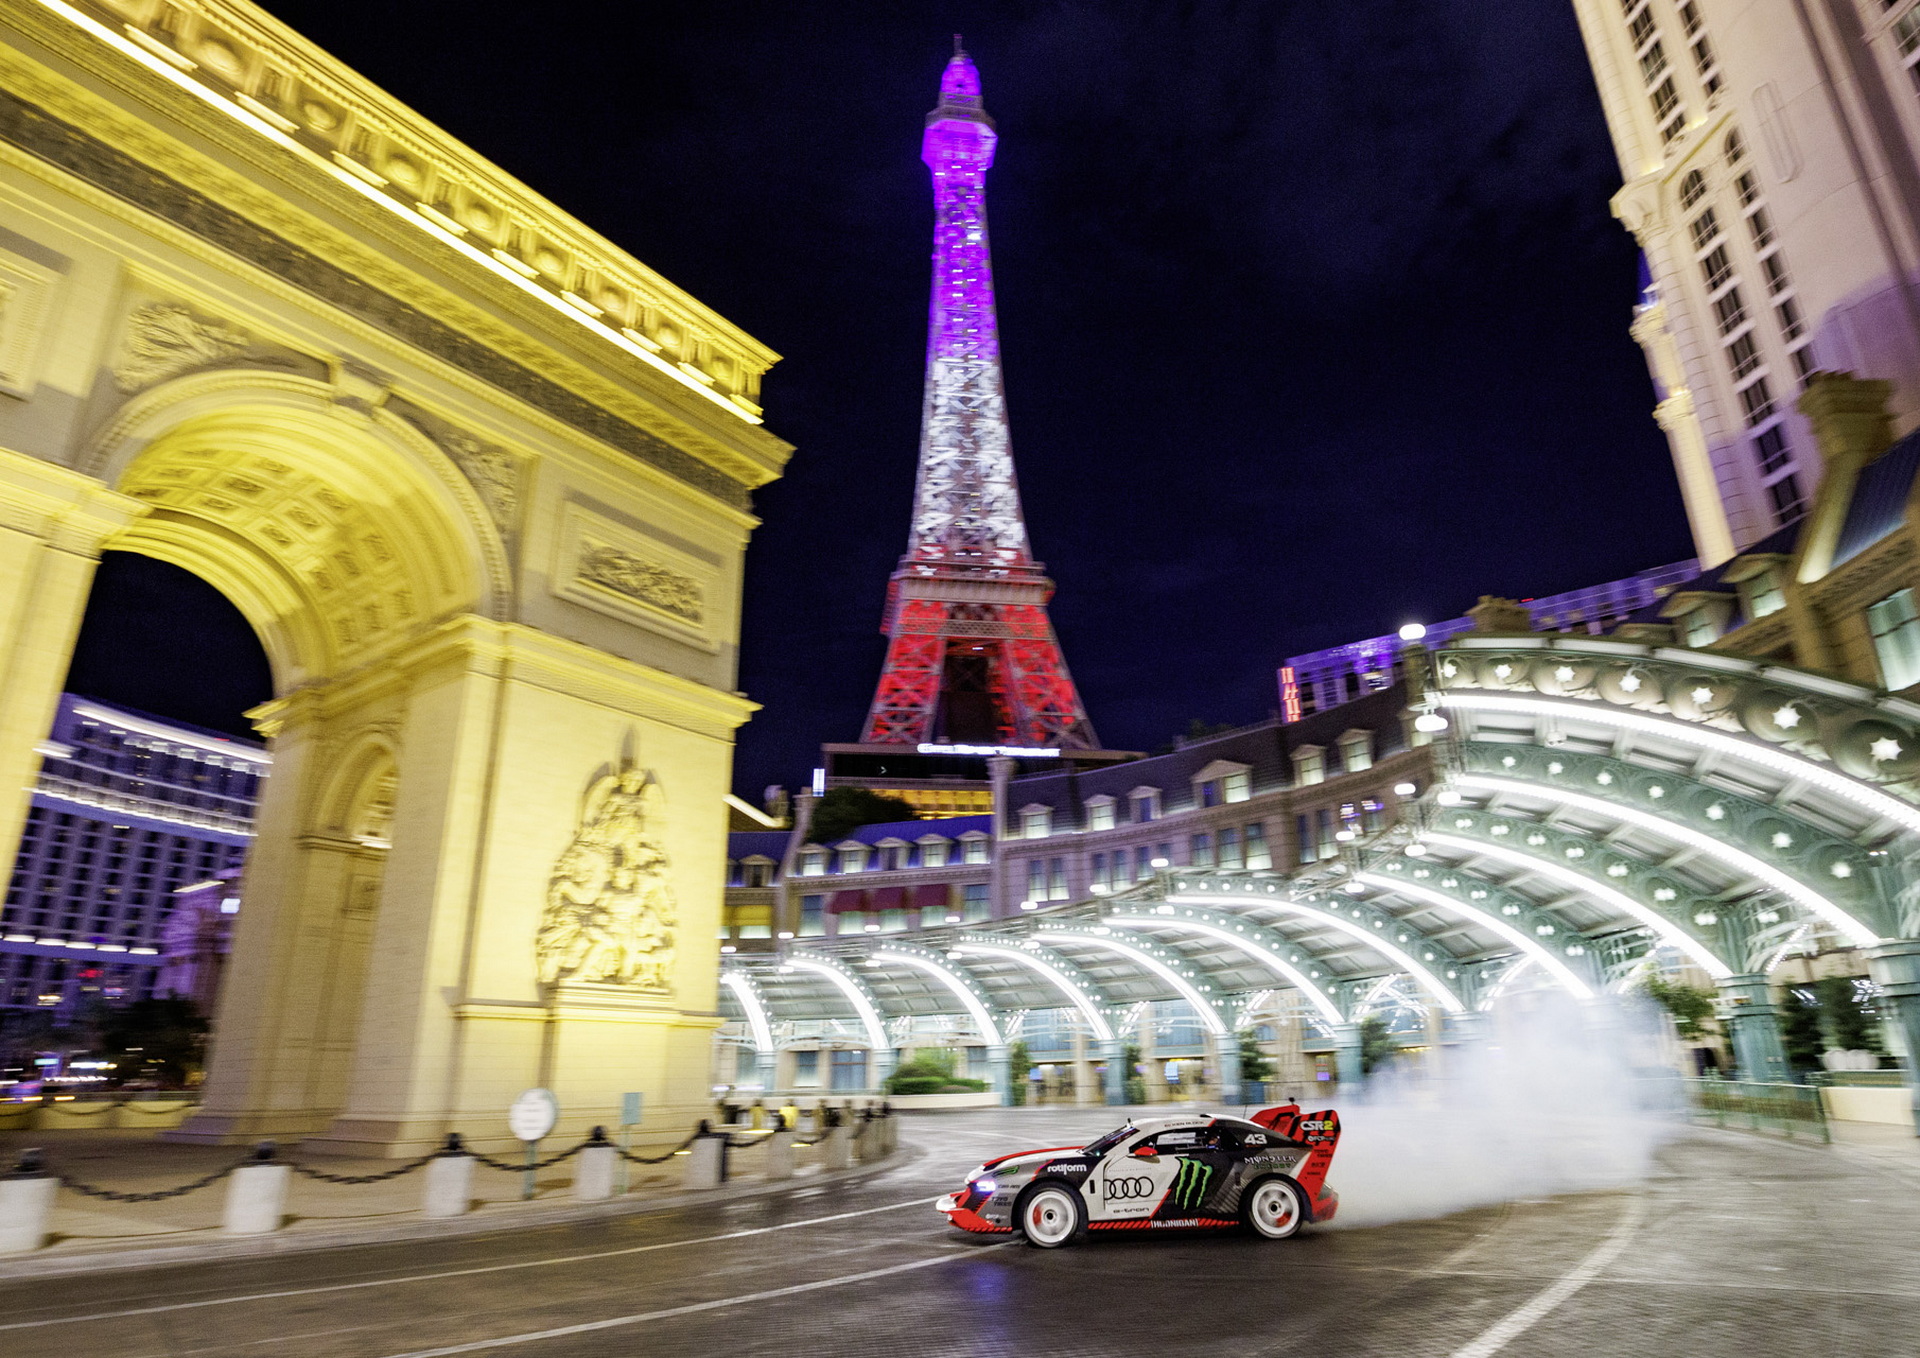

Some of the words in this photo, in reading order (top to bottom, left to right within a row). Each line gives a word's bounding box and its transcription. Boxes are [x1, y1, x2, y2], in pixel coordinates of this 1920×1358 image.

[1300, 1120, 1334, 1131] CSR2
[1244, 1133, 1267, 1145] 43
[1047, 1163, 1087, 1175] rotiform
